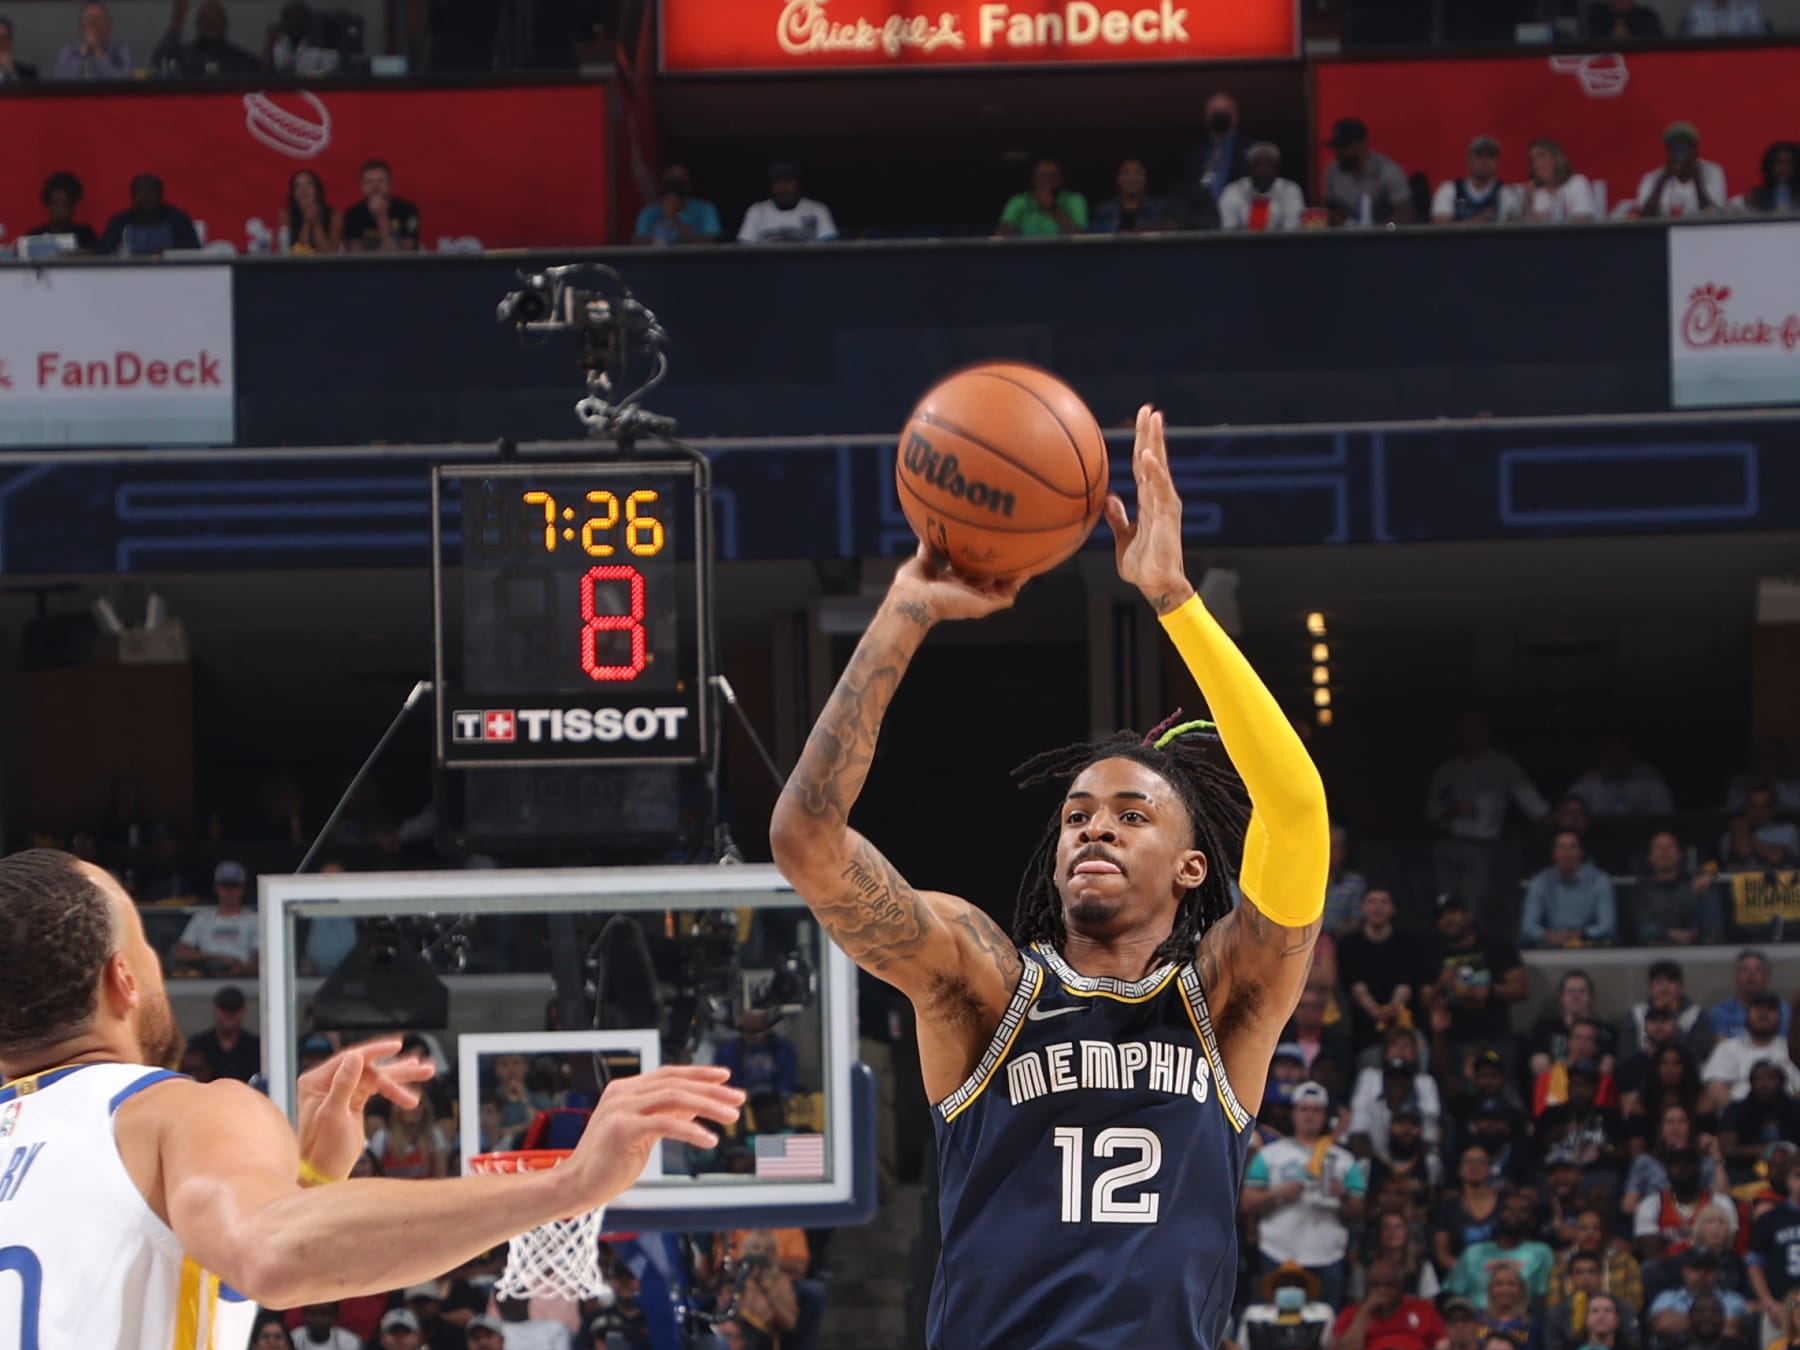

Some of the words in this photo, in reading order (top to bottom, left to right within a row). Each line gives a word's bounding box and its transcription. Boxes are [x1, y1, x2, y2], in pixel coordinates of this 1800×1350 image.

[979, 0, 1191, 48] FanDeck
[36, 350, 223, 389] FanDeck
[903, 429, 1017, 519] Wilson
[523, 490, 665, 557] 7:26
[580, 565, 646, 681] 8
[518, 707, 688, 742] TISSOT
[1006, 1039, 1200, 1107] MEMPHIS
[1053, 1126, 1163, 1224] 12
